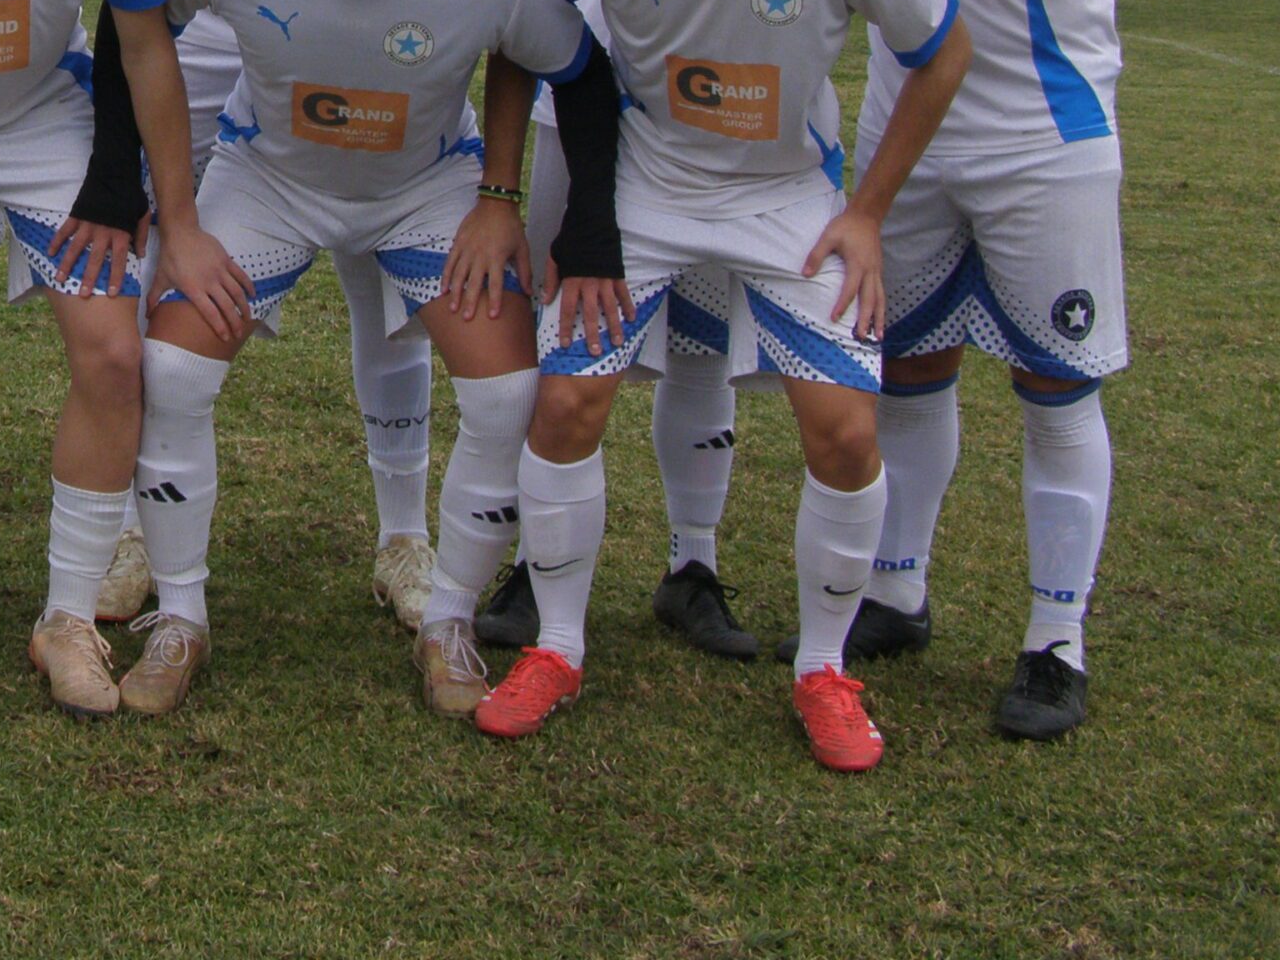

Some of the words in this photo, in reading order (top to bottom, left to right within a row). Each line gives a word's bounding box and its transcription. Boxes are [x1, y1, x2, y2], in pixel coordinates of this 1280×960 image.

[676, 65, 769, 107] GRAND
[302, 91, 396, 127] GRAND
[716, 108, 764, 121] MASTER
[722, 119, 763, 131] GROUP
